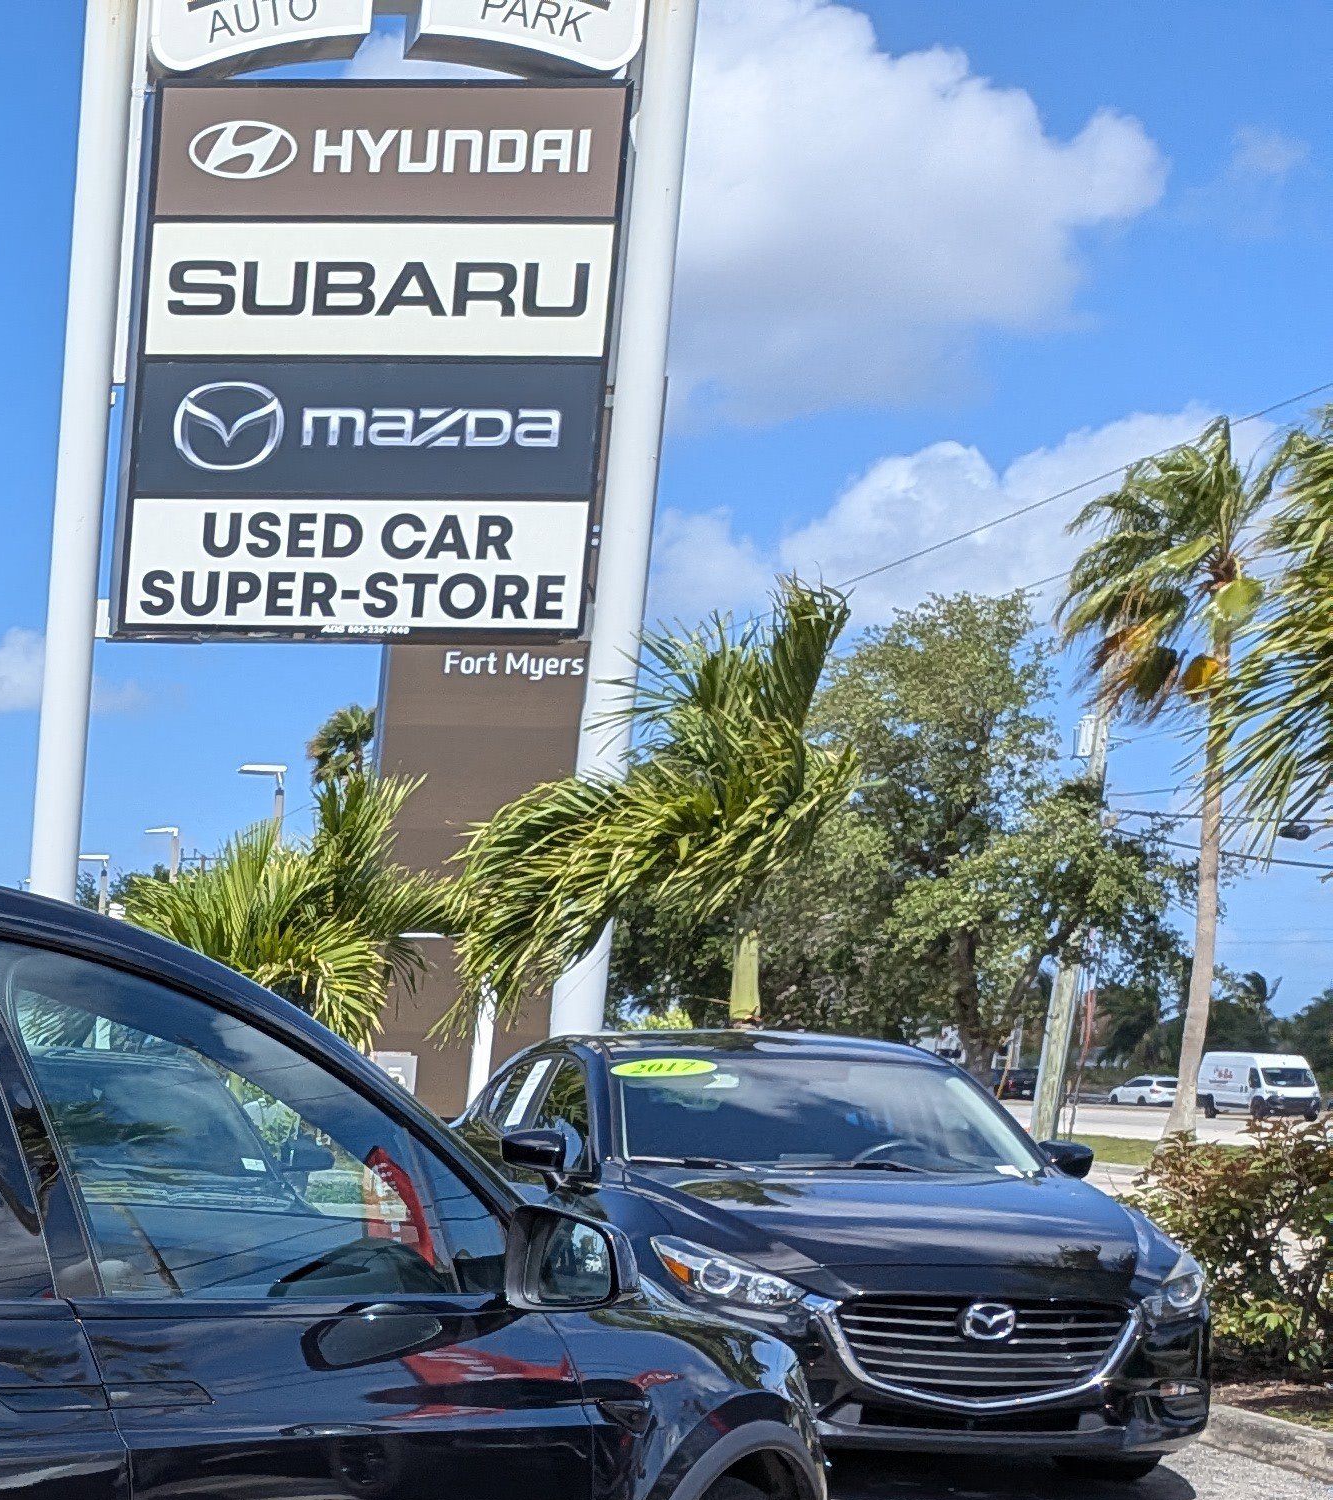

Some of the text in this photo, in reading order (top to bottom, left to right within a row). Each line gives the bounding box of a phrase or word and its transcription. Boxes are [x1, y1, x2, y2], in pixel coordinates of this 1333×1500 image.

[208, 0, 591, 43] AUTO PARK
[312, 129, 592, 173] HYUNDAI
[166, 260, 591, 318] SUBARU
[202, 511, 513, 561] USED CAR
[139, 569, 566, 620] SUPER-STORE
[443, 651, 584, 681] Fort Myers
[630, 1061, 697, 1075] 2017
